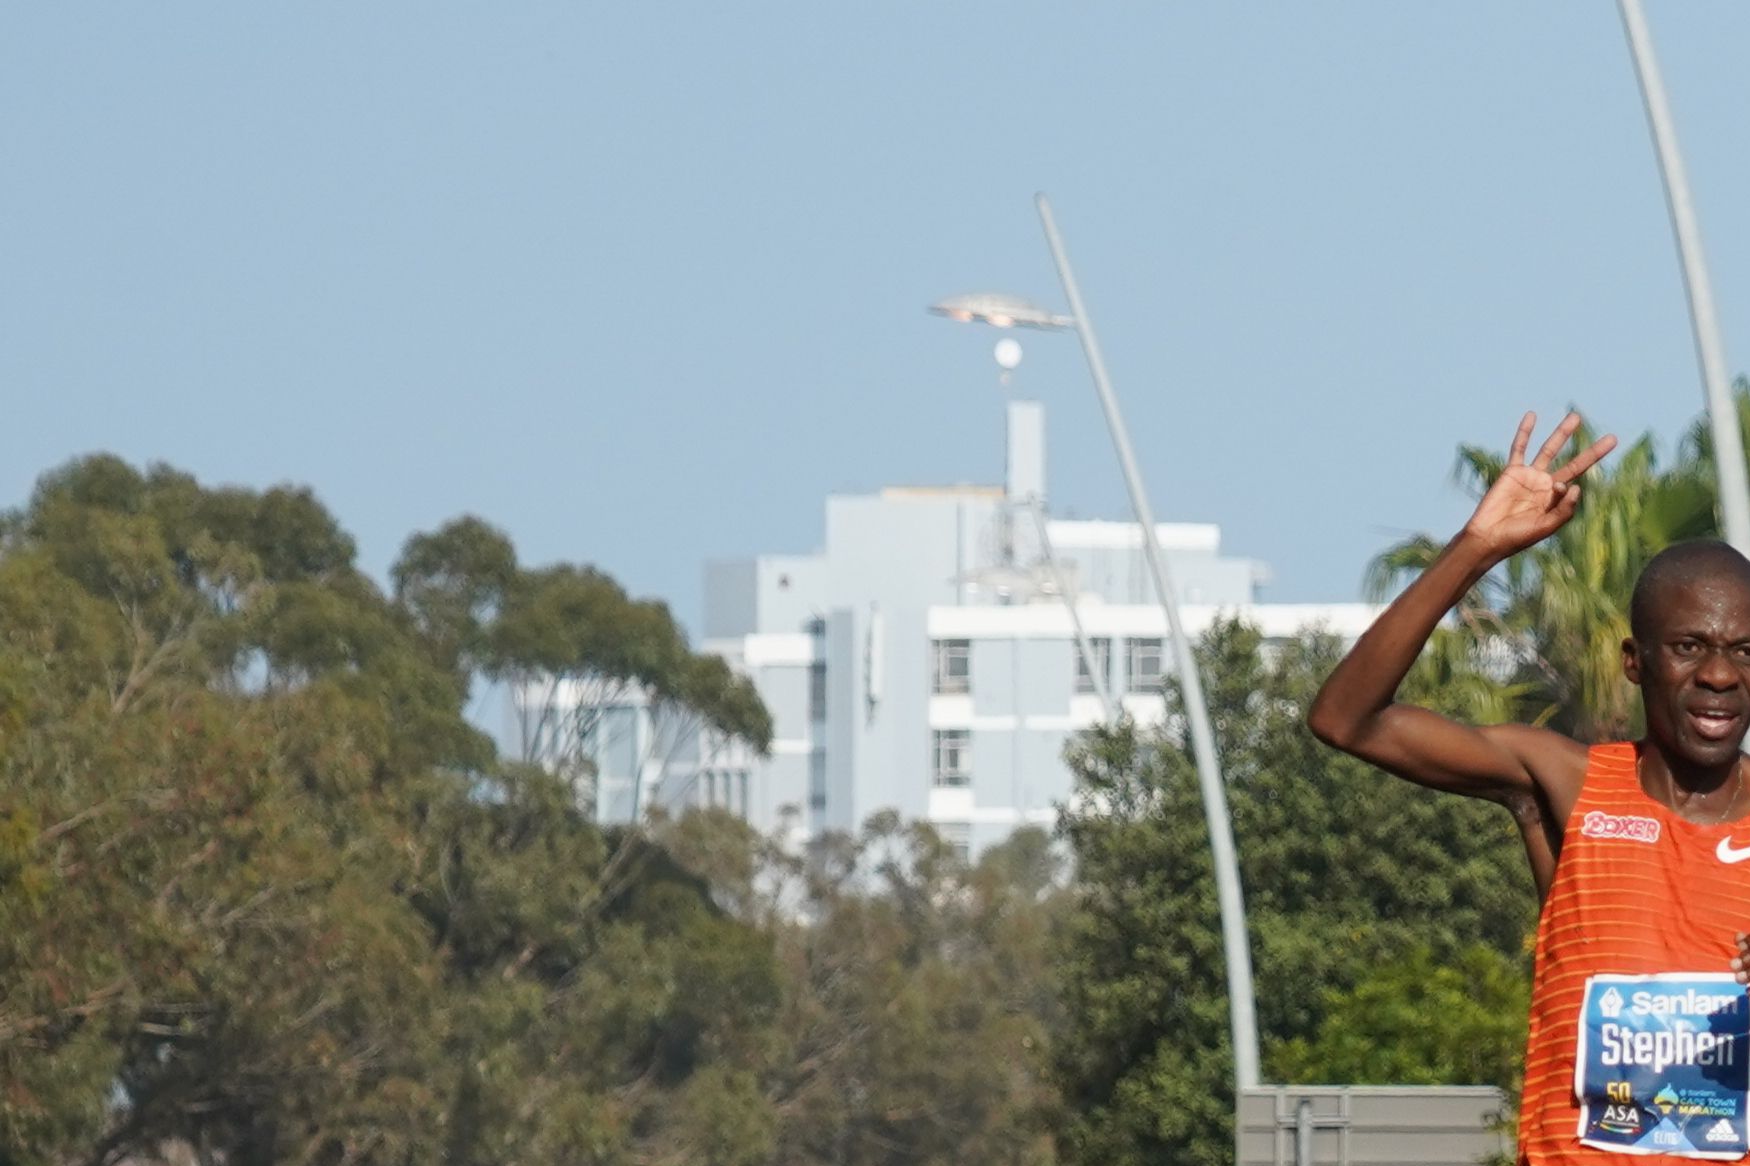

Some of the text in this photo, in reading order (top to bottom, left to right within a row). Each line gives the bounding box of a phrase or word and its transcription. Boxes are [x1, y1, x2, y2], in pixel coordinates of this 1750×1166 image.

[1632, 989, 1738, 1015] Sanlam
[1602, 1020, 1734, 1073] Stephen
[1607, 1082, 1632, 1104] 50
[1680, 1098, 1737, 1107] CAPE TOWN
[1603, 1104, 1640, 1123] ASA
[1679, 1106, 1736, 1116] MARATHON
